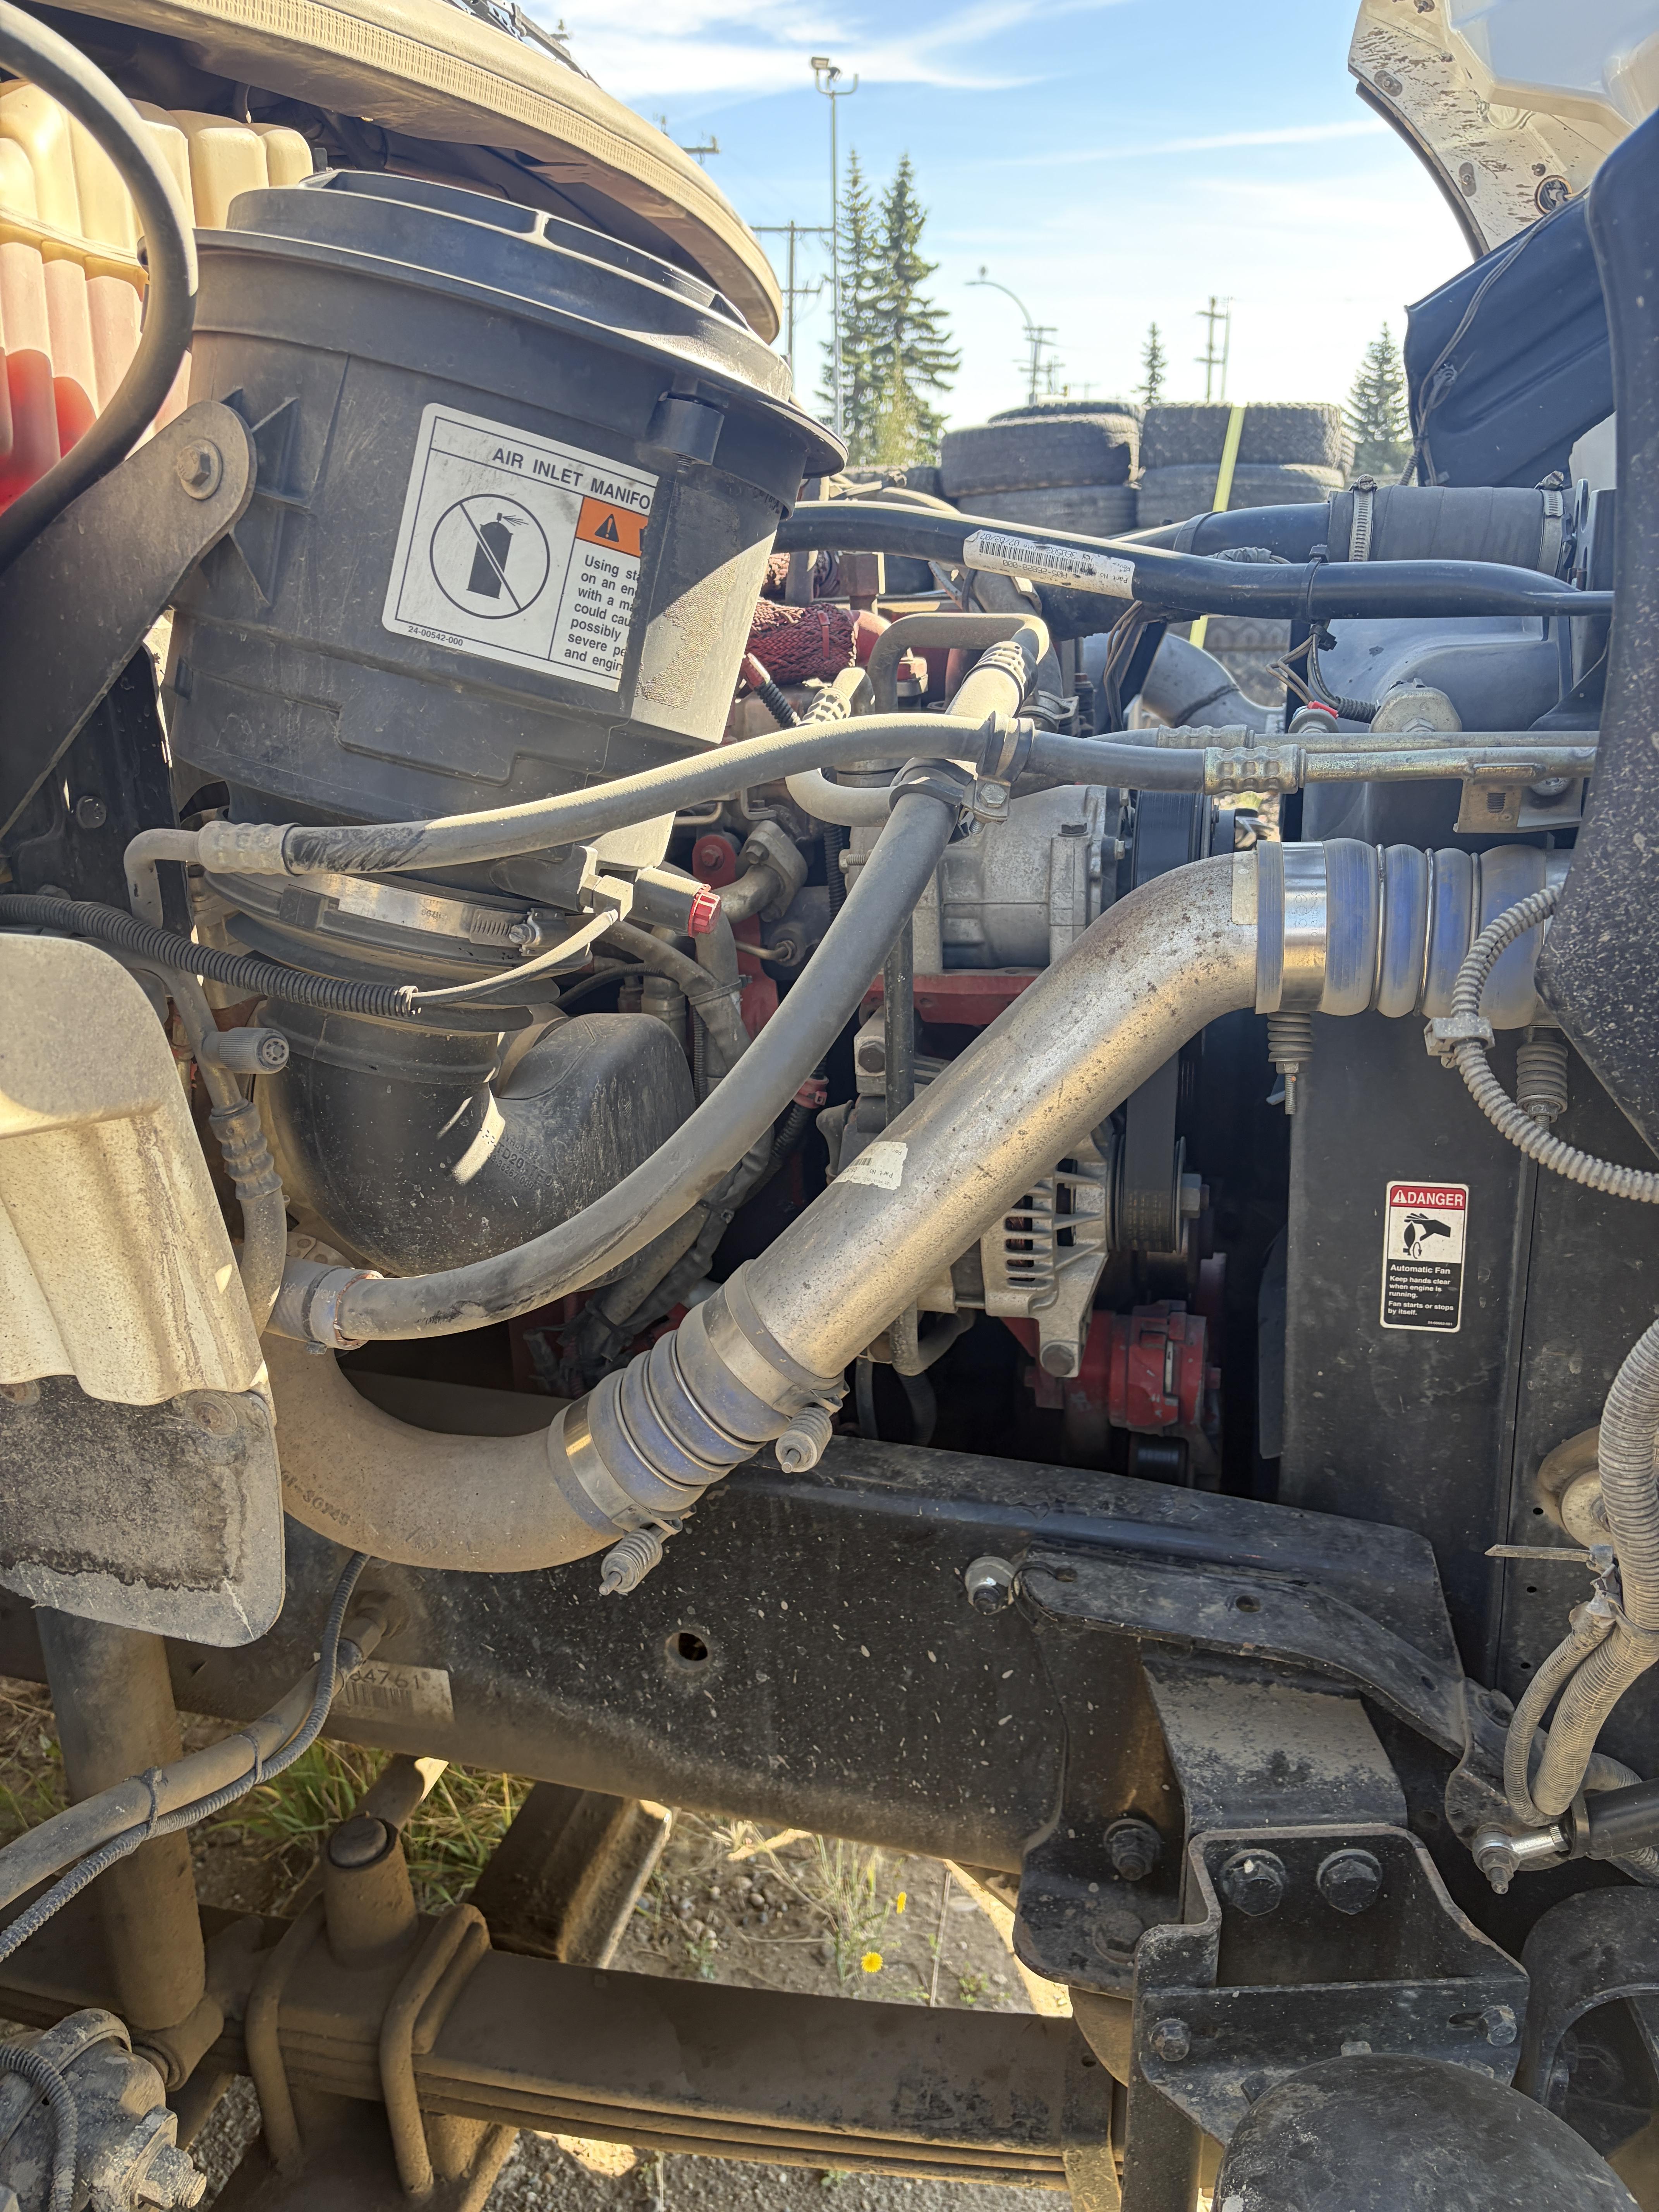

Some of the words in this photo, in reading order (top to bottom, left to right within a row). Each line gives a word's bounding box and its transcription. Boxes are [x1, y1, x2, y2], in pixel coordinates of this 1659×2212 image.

[492, 448, 524, 469] AIR
[533, 459, 583, 486] INLET
[591, 478, 651, 509] MANIFO
[980, 533, 1020, 546] 07/02/07
[585, 555, 620, 578] Using
[581, 573, 596, 584] on
[601, 579, 616, 590] an
[621, 585, 636, 596] en
[578, 587, 602, 602] with
[607, 597, 614, 606] a
[574, 603, 607, 620] could
[611, 614, 630, 626] cau
[408, 625, 463, 646] 24-00542-000
[570, 618, 621, 642] possibly
[564, 649, 587, 662] and
[568, 633, 607, 651] severe
[613, 646, 626, 657] pe
[1408, 1192, 1463, 1206] DANGER
[1390, 1264, 1433, 1273] Automatic
